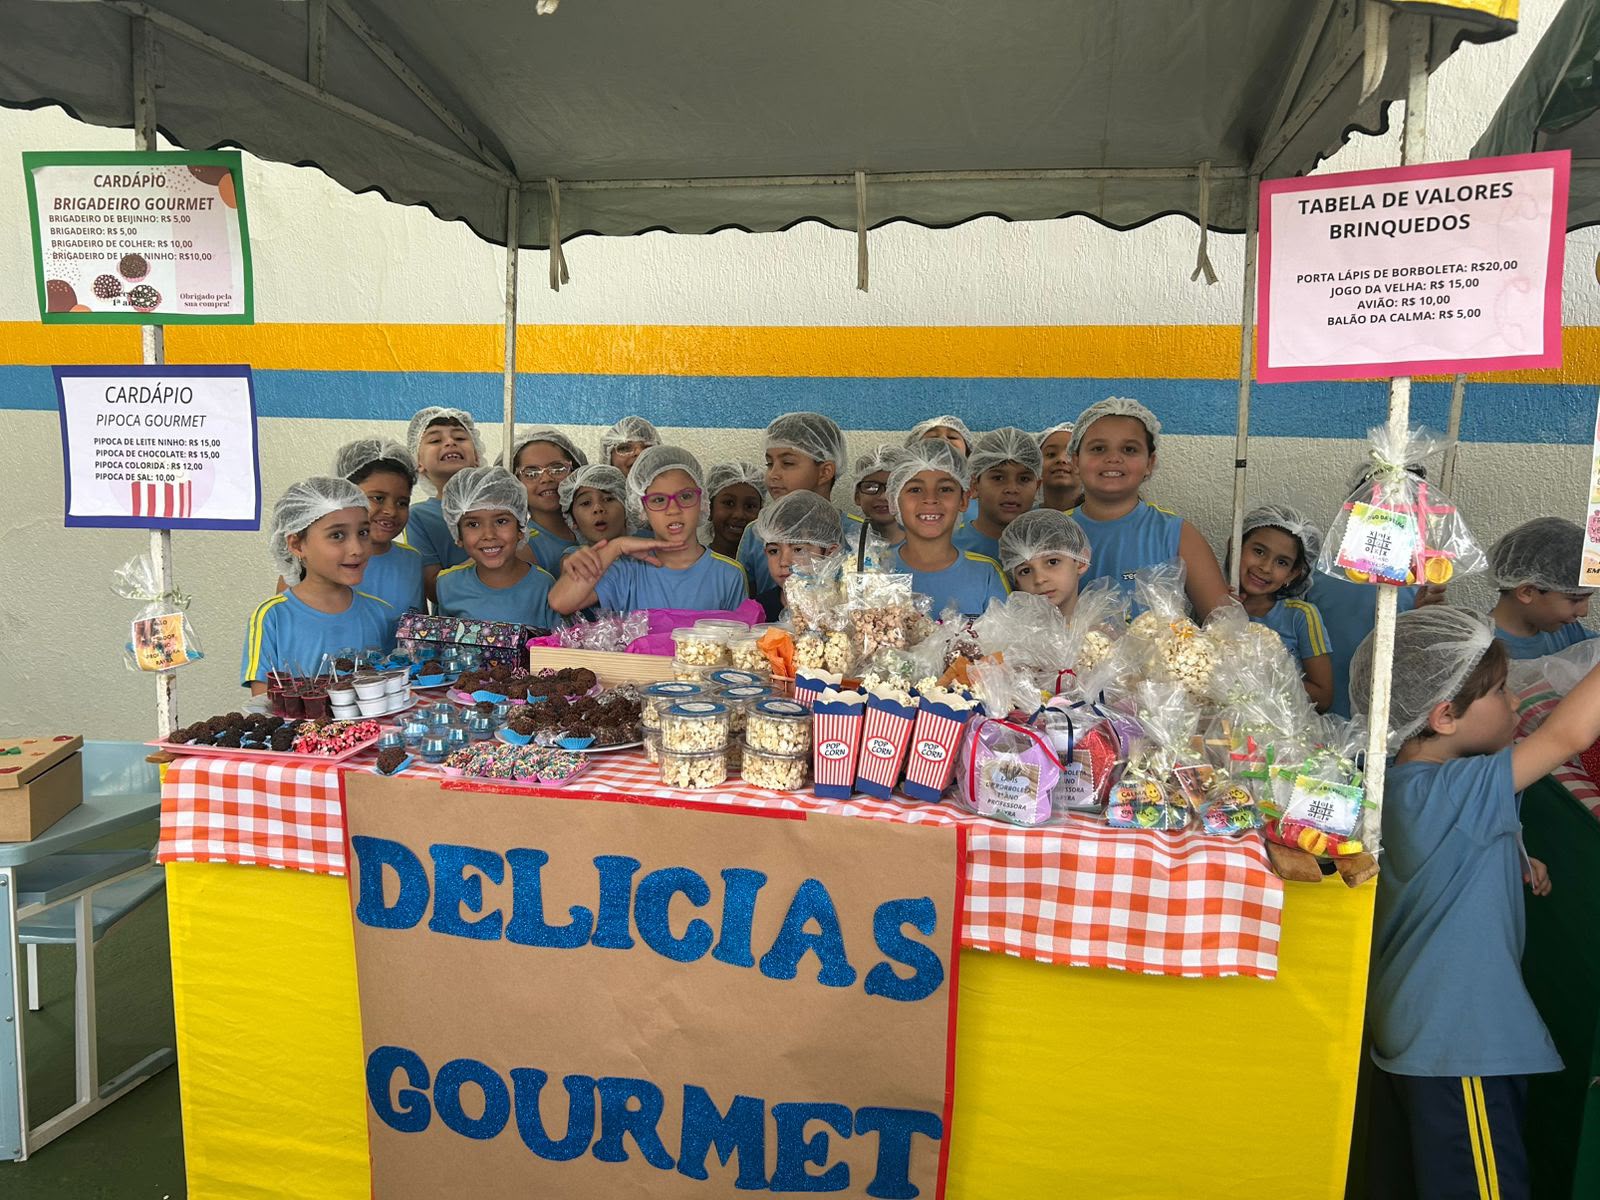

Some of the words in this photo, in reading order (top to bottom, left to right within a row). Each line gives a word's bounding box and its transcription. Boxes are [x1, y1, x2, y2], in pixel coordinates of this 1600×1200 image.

[94, 171, 166, 188] CARDÁPIO
[53, 197, 140, 211] BRIGADEIRO
[144, 197, 214, 211] GOURMET
[1298, 195, 1377, 215] TABELA
[1382, 191, 1409, 208] DE
[1415, 182, 1514, 205] VALORES
[49, 215, 101, 223] BRIGADEIRO
[103, 215, 115, 223] DE
[116, 215, 159, 225] BEIJINHO:
[160, 214, 172, 224] R$
[173, 215, 191, 224] 5,00
[50, 227, 105, 236] BRIGADEIRO:
[107, 227, 118, 236] R$
[119, 227, 138, 236] 5,00
[1329, 214, 1471, 240] BRINQUEDOS
[51, 239, 104, 248] BRIGADEIRO
[106, 240, 118, 248] DE
[119, 240, 156, 248] COLHER:
[157, 239, 169, 249] R$
[170, 240, 193, 249] 10,00
[52, 252, 104, 261] BRIGADEIRO
[106, 252, 118, 261] DE
[144, 252, 177, 261] NINHO:
[178, 252, 212, 262] R$10,00
[1297, 272, 1335, 284] PORTA
[1338, 268, 1370, 282] LÁPIS
[1373, 269, 1389, 279] DE
[1391, 263, 1468, 278] BORBOLETA:
[1470, 260, 1518, 273] R$20,00
[1330, 285, 1362, 298] JOGO
[1364, 284, 1382, 295] DA
[1384, 282, 1427, 294] VELHA:
[1430, 279, 1445, 291] R$
[1448, 278, 1479, 290] 15,00
[180, 292, 215, 302] Obrigado
[216, 294, 232, 302] pela
[1357, 296, 1398, 310] AVIÃO:
[1401, 295, 1416, 307] R$
[1419, 294, 1450, 306] 10,00
[199, 301, 230, 309] compra!
[1327, 312, 1367, 326] BALÃO
[1370, 313, 1387, 324] DA
[1389, 310, 1436, 323] CALMA:
[1438, 309, 1454, 320] R$
[1456, 308, 1481, 320] 5,00
[105, 382, 193, 404] CARDÁPIO
[96, 414, 141, 427] PIPOCA
[145, 414, 207, 427] GOURMET
[94, 437, 122, 446] PIPOCA
[124, 438, 134, 446] DE
[135, 438, 156, 446] LEITE
[157, 438, 187, 447] NINHO:
[188, 438, 198, 447] R$
[200, 439, 221, 448] 15,00
[96, 450, 124, 458] PIPOCA
[126, 450, 136, 458] DE
[137, 450, 187, 459] CHOCOLATE:
[188, 450, 198, 459] R$
[199, 451, 220, 460] 15,00
[95, 461, 124, 469] PIPOCA
[126, 461, 165, 470] COLORIDA
[170, 462, 181, 471] R$
[183, 462, 203, 471] 12,00
[95, 473, 124, 481] PIPOCA
[126, 473, 136, 481] DE
[137, 473, 154, 482] SAL:
[155, 474, 175, 482] 10,00
[873, 739, 888, 747] POP
[923, 742, 939, 750] POP
[871, 747, 892, 756] CORN
[921, 749, 943, 758] CORN
[351, 835, 944, 1002] DELICIAS
[365, 1045, 943, 1199] GOURMET
